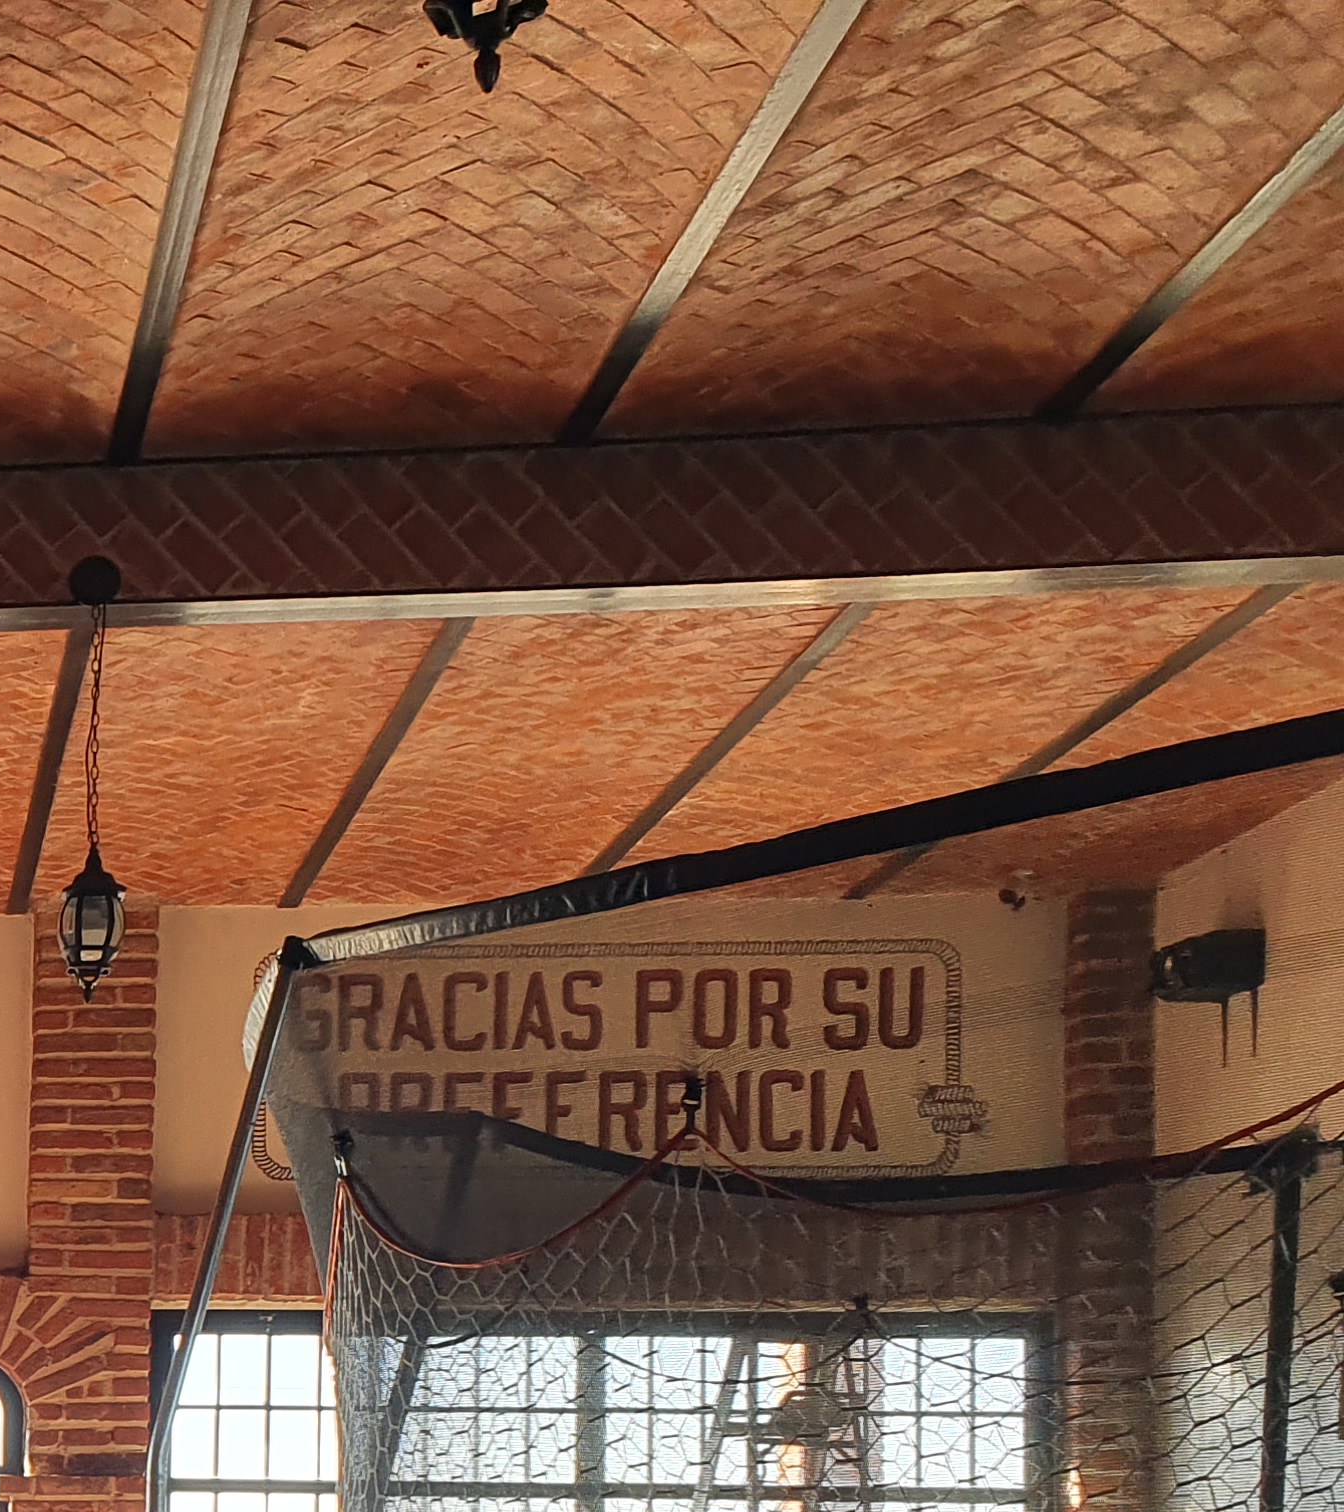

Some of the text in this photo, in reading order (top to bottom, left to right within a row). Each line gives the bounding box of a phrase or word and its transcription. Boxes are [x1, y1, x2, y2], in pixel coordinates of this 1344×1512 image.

[289, 966, 925, 1052] GRACIAS POR SU
